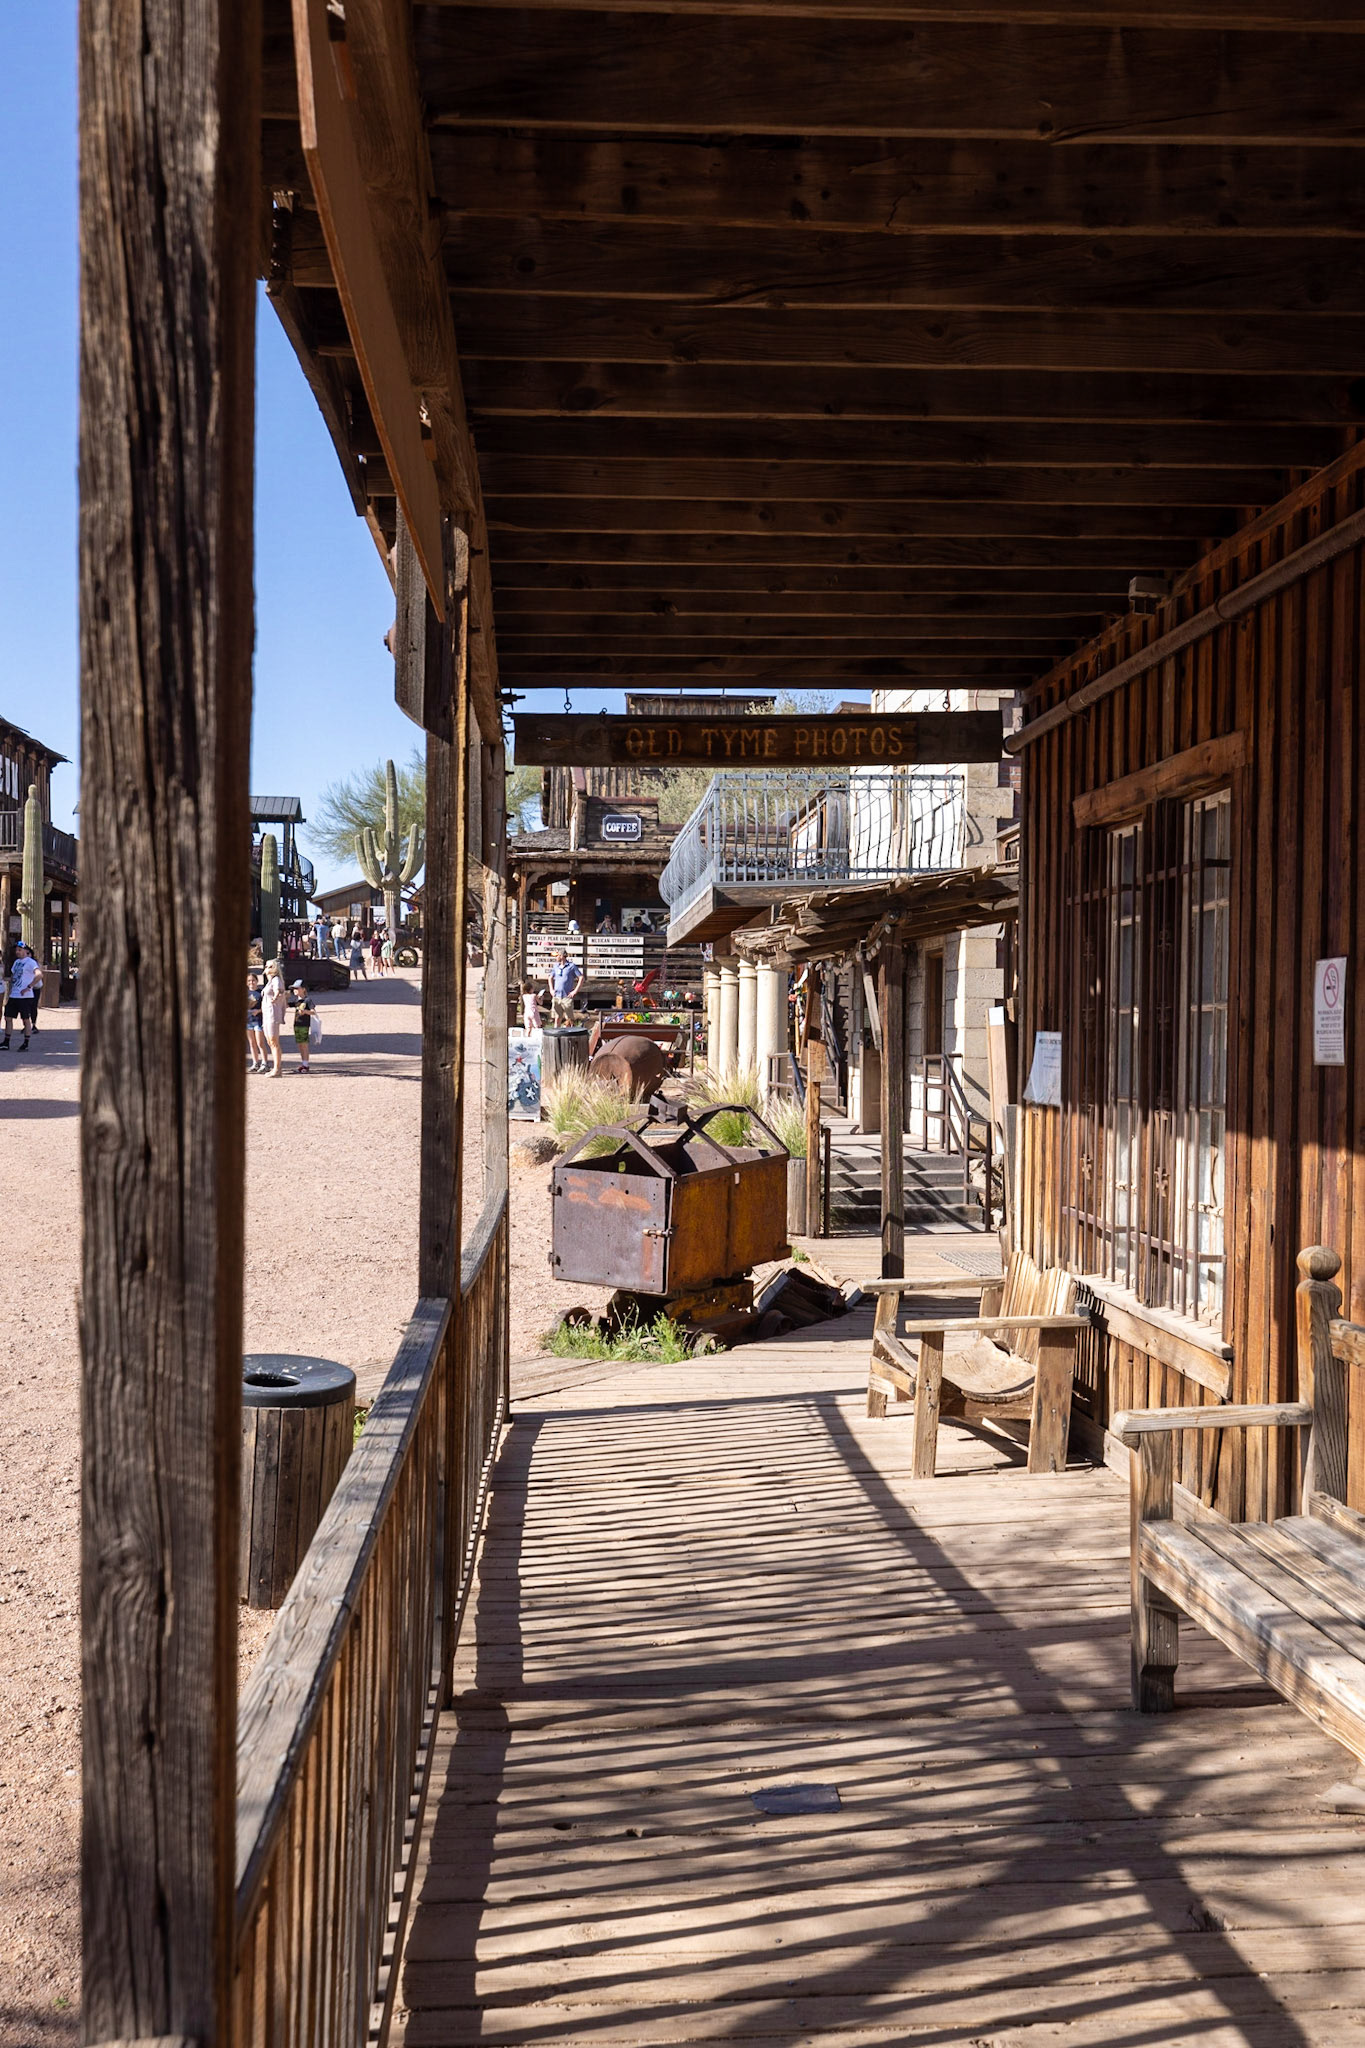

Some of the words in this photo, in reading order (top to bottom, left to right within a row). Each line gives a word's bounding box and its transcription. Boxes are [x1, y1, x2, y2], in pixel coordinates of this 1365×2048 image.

[625, 728, 683, 757] OLD
[702, 728, 778, 757] TYME
[793, 727, 904, 756] PHOTOS
[606, 822, 637, 833] COFFEE
